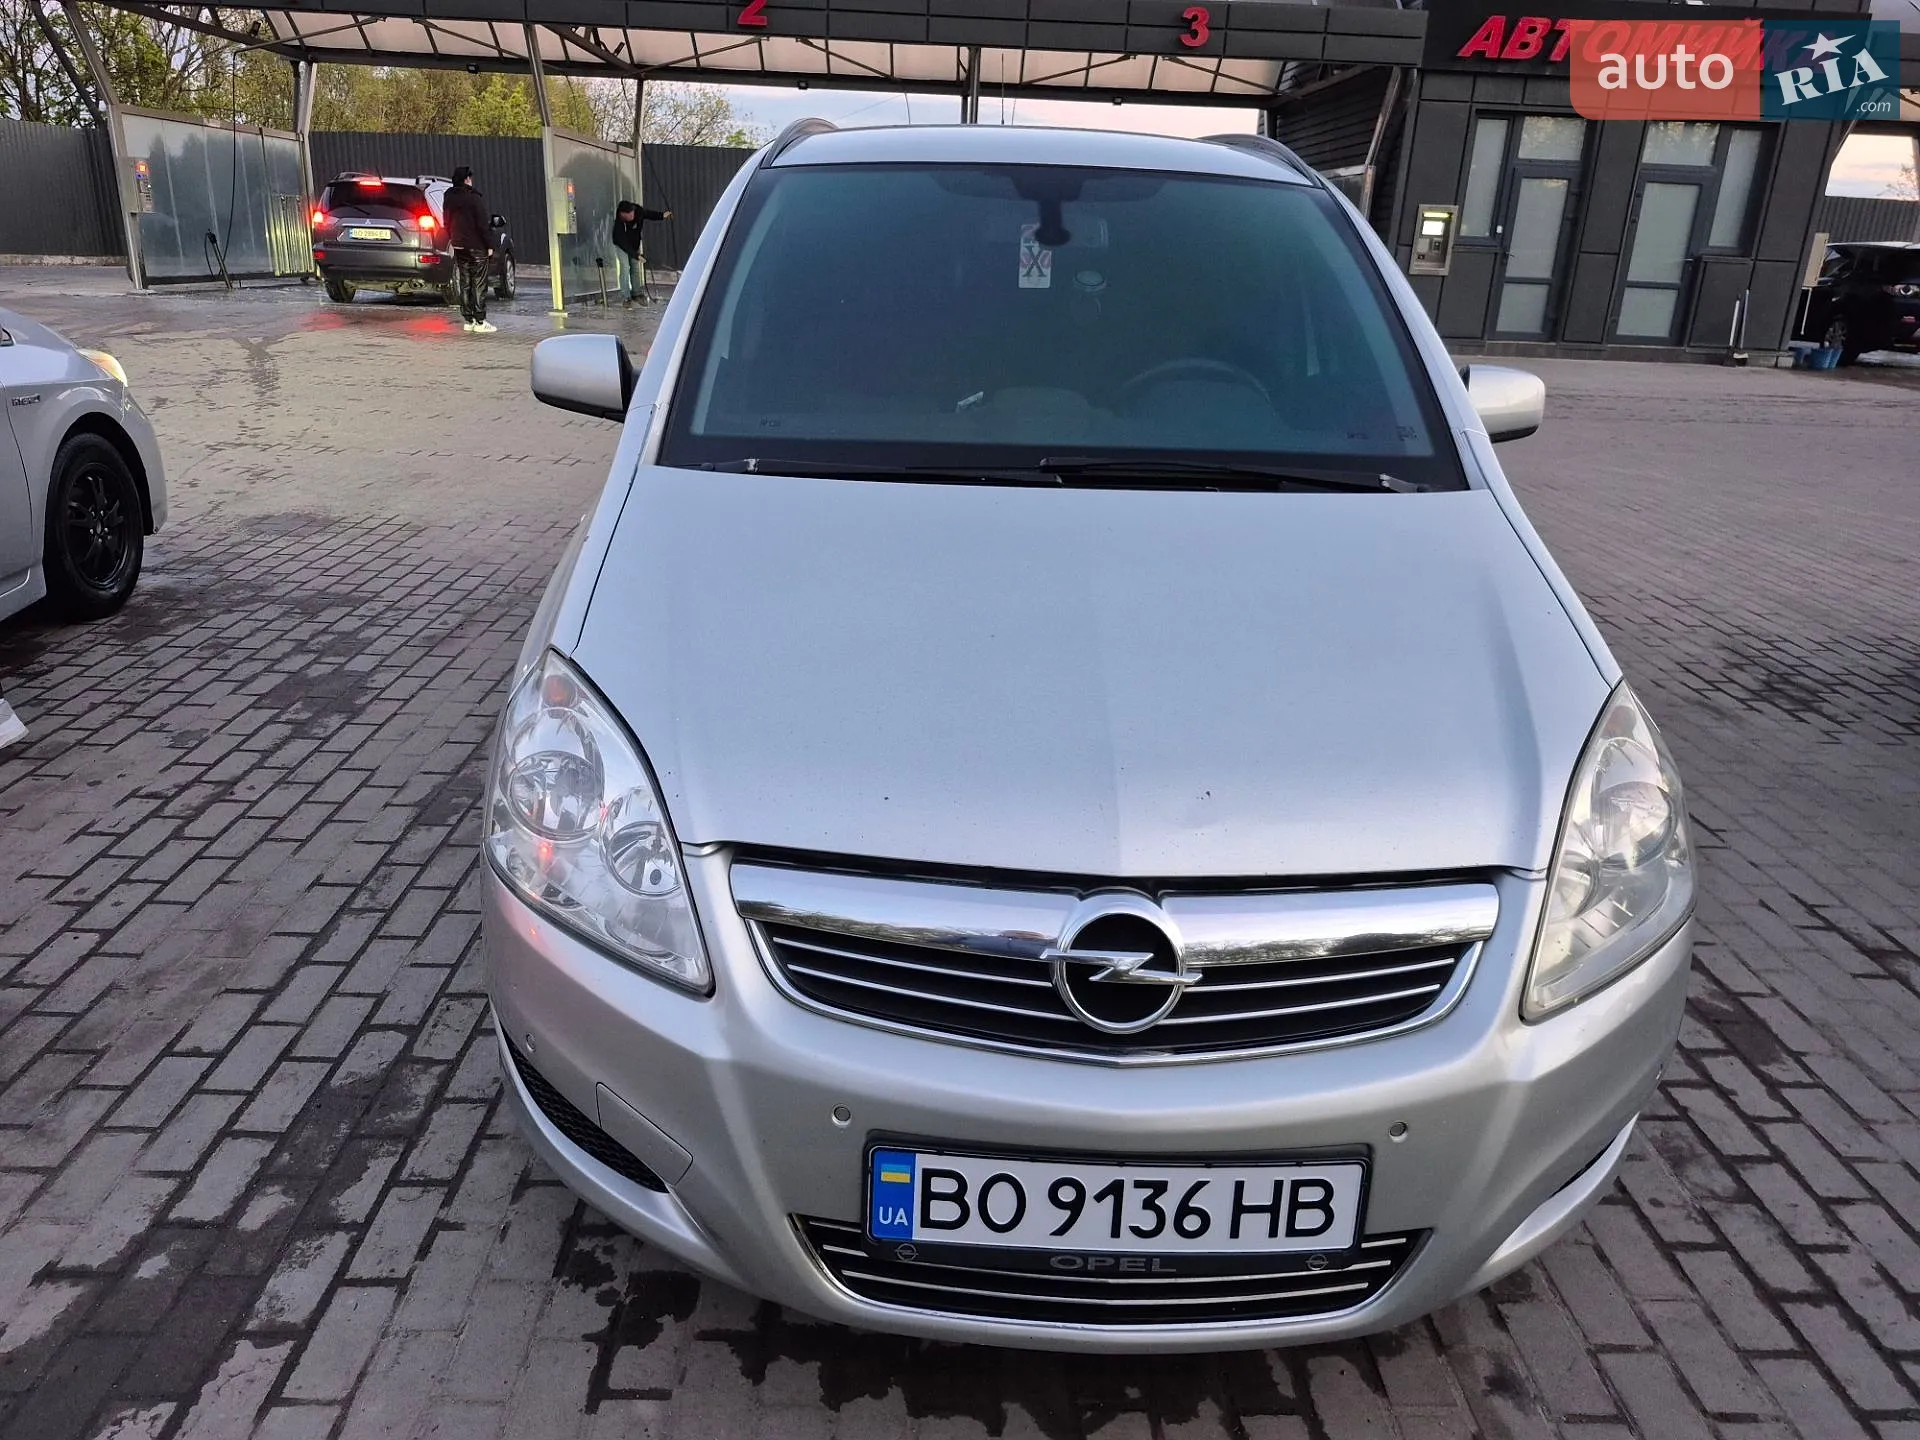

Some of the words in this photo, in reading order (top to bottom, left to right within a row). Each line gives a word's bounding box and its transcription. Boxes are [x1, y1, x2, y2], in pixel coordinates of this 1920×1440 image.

[737, 0, 768, 26] 2
[1180, 7, 1210, 47] 3
[879, 1206, 909, 1226] UA
[920, 1168, 1027, 1234] BO
[1047, 1177, 1211, 1239] 9136
[1229, 1178, 1335, 1239] HB
[1050, 1255, 1177, 1273] OPEL
